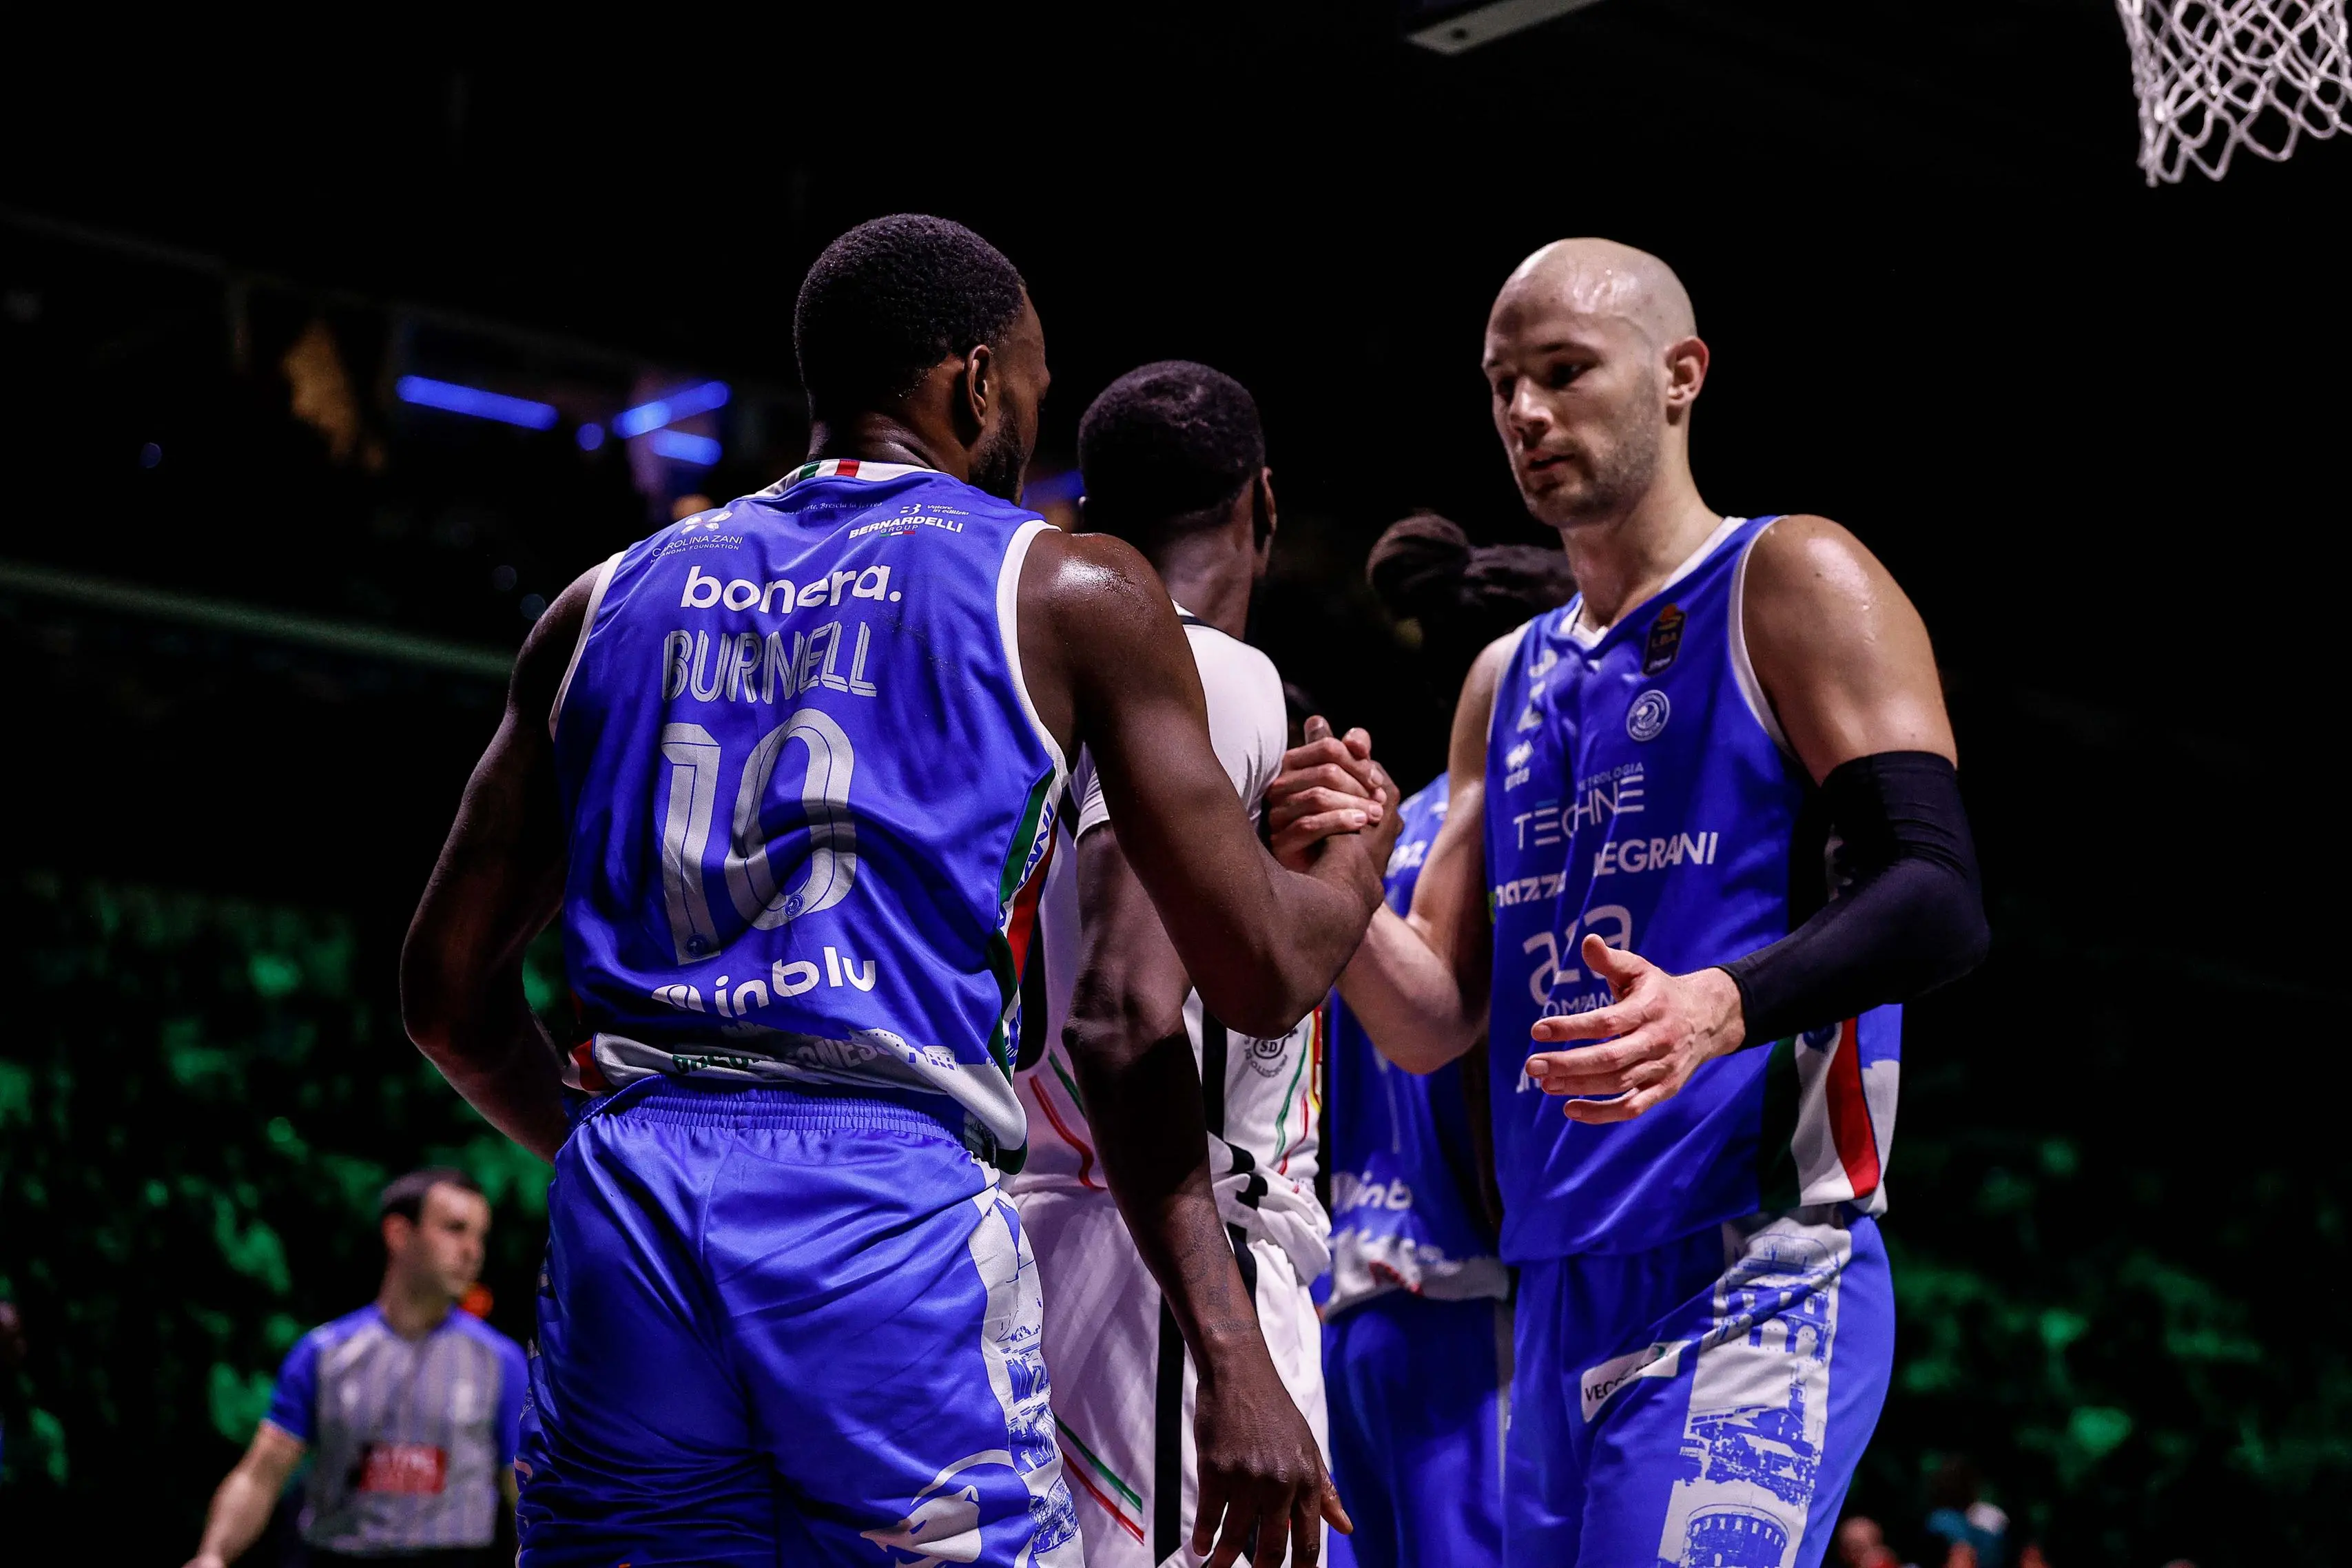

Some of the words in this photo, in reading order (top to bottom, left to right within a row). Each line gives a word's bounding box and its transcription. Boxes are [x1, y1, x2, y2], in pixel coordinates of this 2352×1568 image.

[711, 535, 743, 544] ZANI
[848, 516, 964, 539] BERNARDELLI
[880, 524, 918, 533] GROUP
[680, 565, 901, 614] bonera.
[661, 621, 878, 705] BURNELL
[661, 708, 856, 966] 10
[714, 946, 876, 1018] inblu
